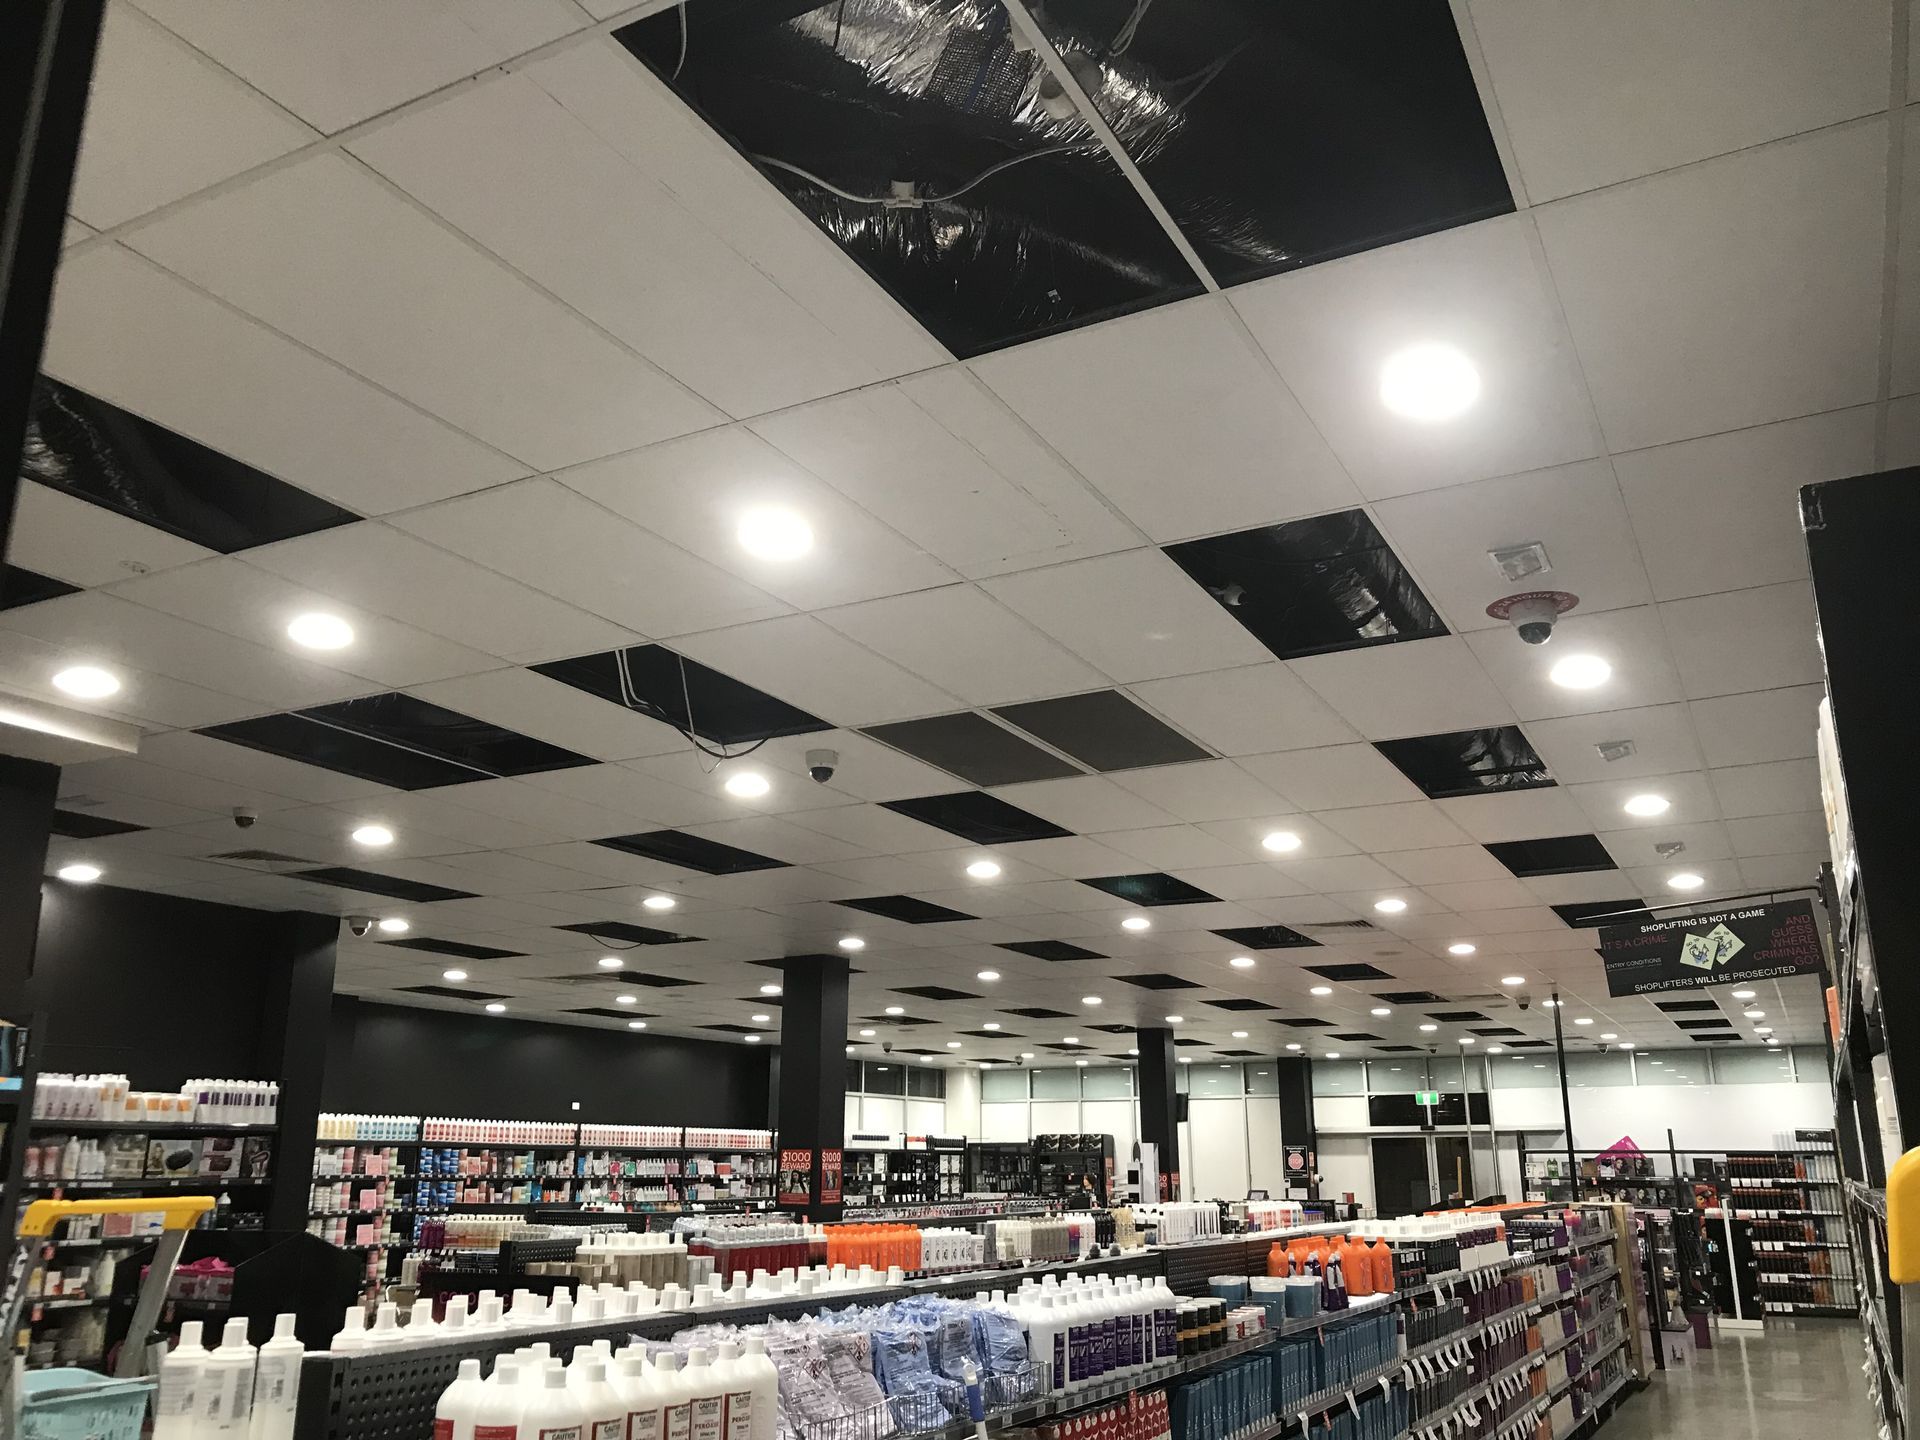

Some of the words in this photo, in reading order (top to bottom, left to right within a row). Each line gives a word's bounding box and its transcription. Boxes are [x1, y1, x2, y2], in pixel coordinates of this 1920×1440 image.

[1640, 918, 1697, 933] SHOPLIFTING
[1699, 917, 1708, 925] IS
[1709, 914, 1728, 924] NOT
[1730, 913, 1737, 921] A
[1738, 908, 1766, 920] GAME
[1785, 914, 1811, 925] AND
[1771, 924, 1814, 938] GUESS
[1624, 941, 1632, 950] A
[1633, 934, 1669, 947] CRIME
[1770, 934, 1816, 948] WHERE
[1753, 944, 1819, 961] CRIMINALS
[1606, 961, 1625, 970] ENTRY
[1626, 957, 1662, 968] CONDITIONS
[1794, 955, 1820, 967] GO?
[1634, 977, 1694, 993] SHOPLIFTERS
[1695, 975, 1718, 985] WILL
[1718, 974, 1731, 983] BE
[1732, 965, 1797, 980] PROSECUTED
[781, 1150, 811, 1162] $1000
[821, 1151, 842, 1162] $1000
[781, 1162, 811, 1170] REWARD
